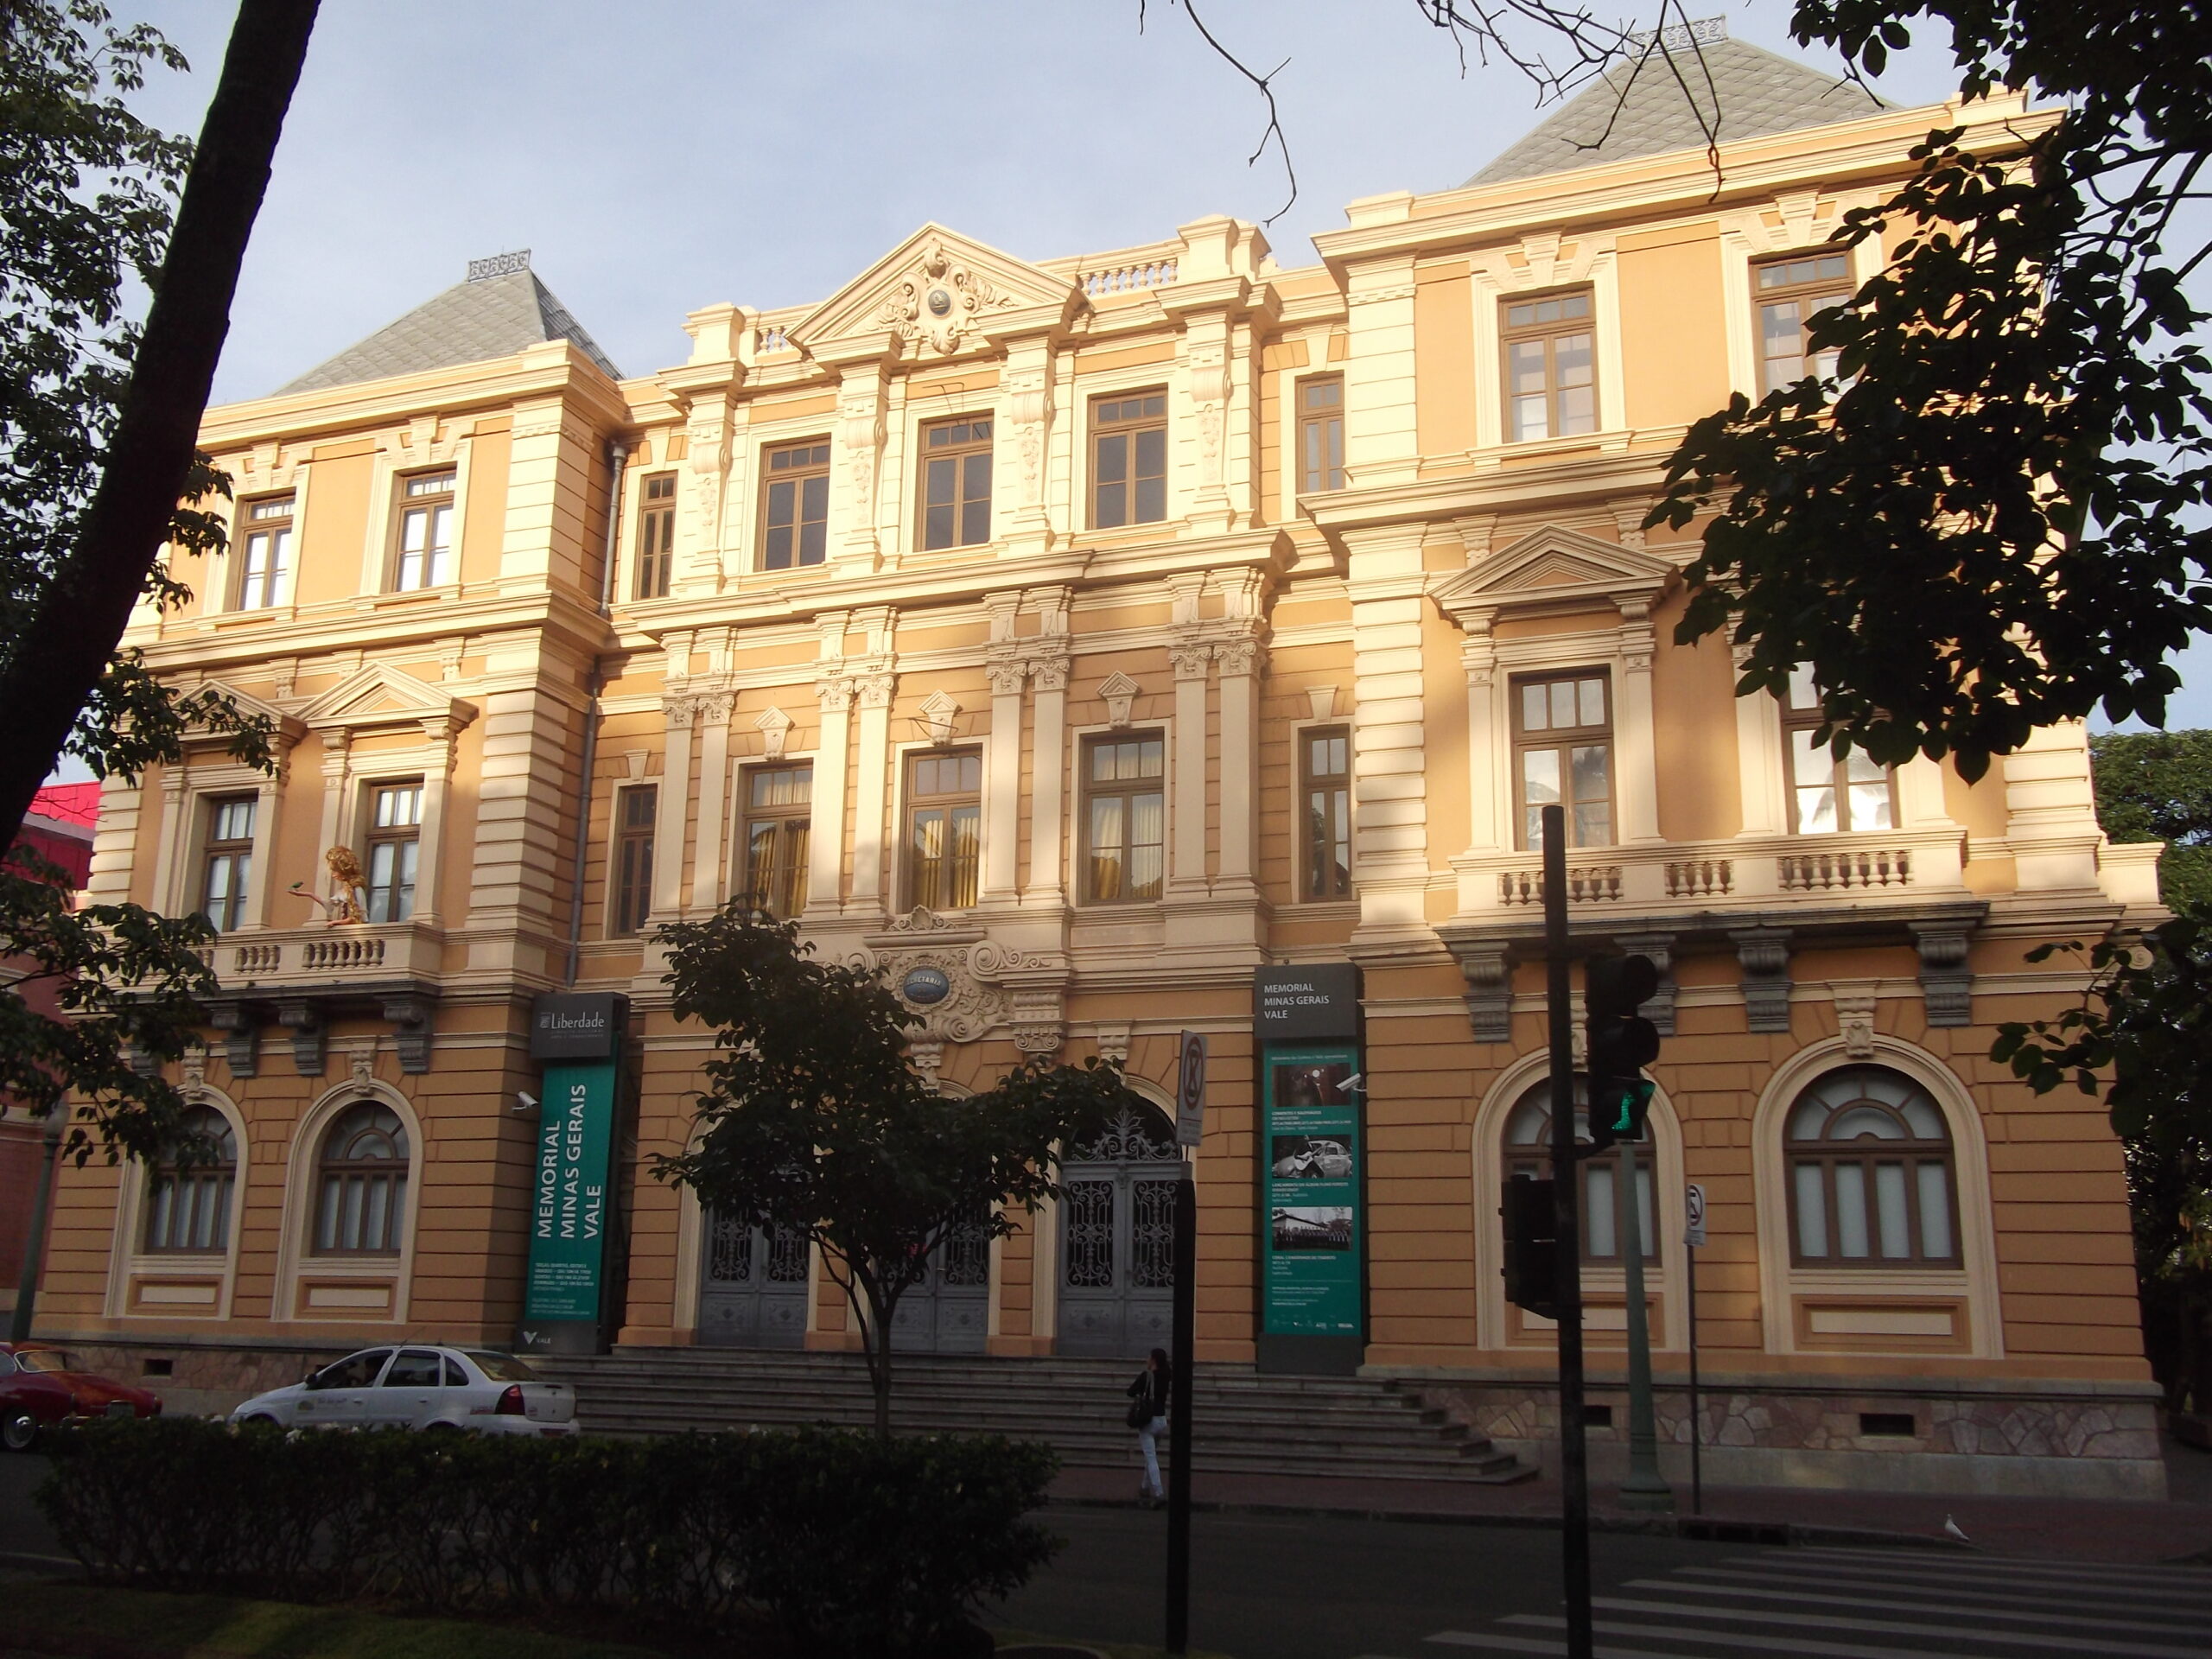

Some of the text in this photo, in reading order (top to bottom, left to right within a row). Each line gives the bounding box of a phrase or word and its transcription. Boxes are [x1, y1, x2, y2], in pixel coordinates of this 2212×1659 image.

[1264, 983, 1314, 993] MEMORIAL
[1264, 995, 1330, 1006] MINAS GERAIS
[551, 1011, 605, 1029] Liberdade
[1264, 1010, 1288, 1019] VALE
[560, 1084, 586, 1238] MINAS GERAIS
[537, 1121, 560, 1237] MEMORIAL
[583, 1185, 601, 1239] VALE
